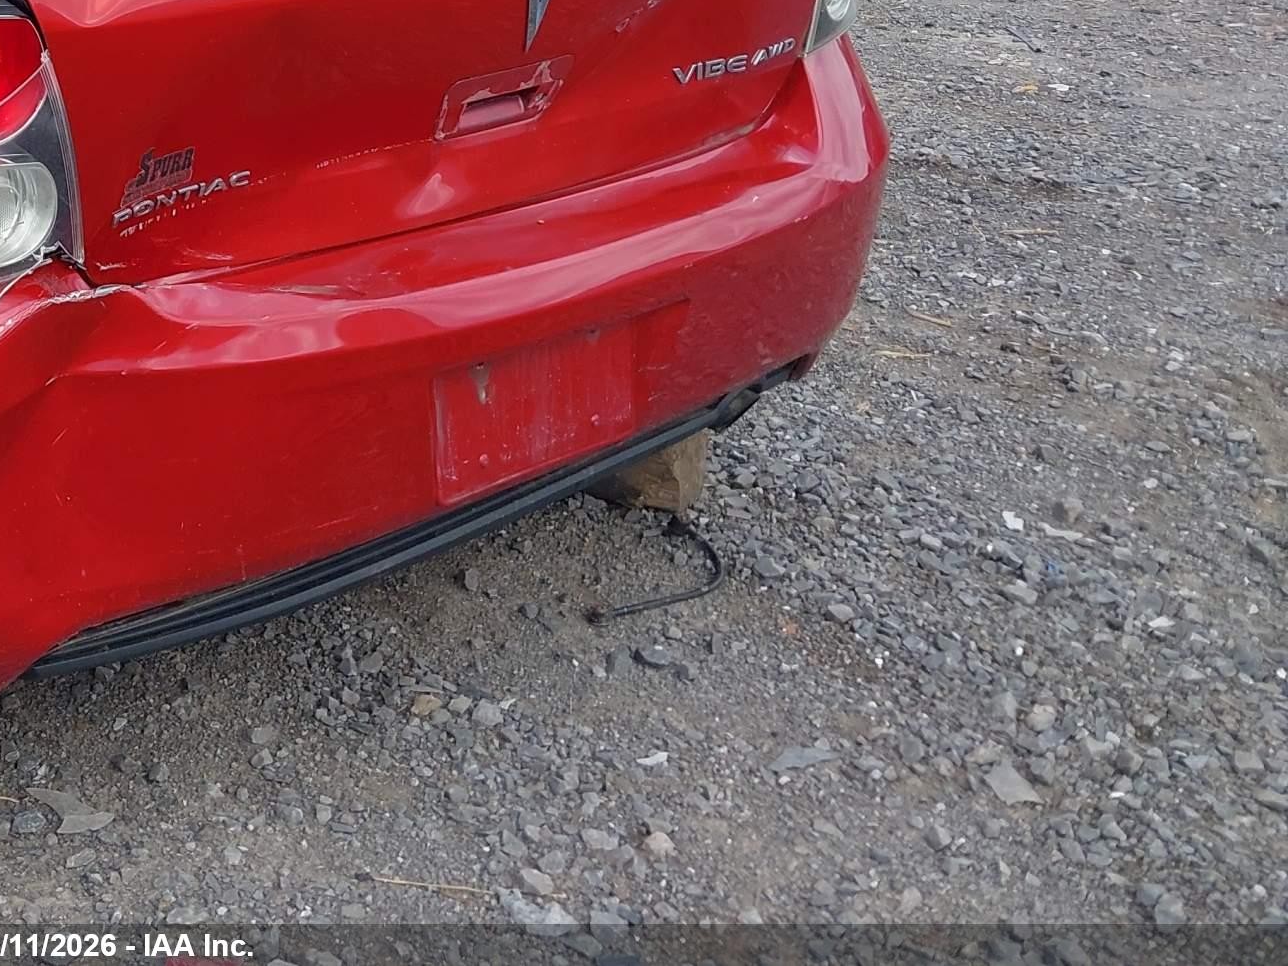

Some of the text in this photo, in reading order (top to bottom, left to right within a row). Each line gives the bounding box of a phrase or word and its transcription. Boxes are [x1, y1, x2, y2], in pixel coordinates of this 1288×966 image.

[673, 37, 796, 84] VIBE AWD
[112, 170, 251, 229] PONTIAC
